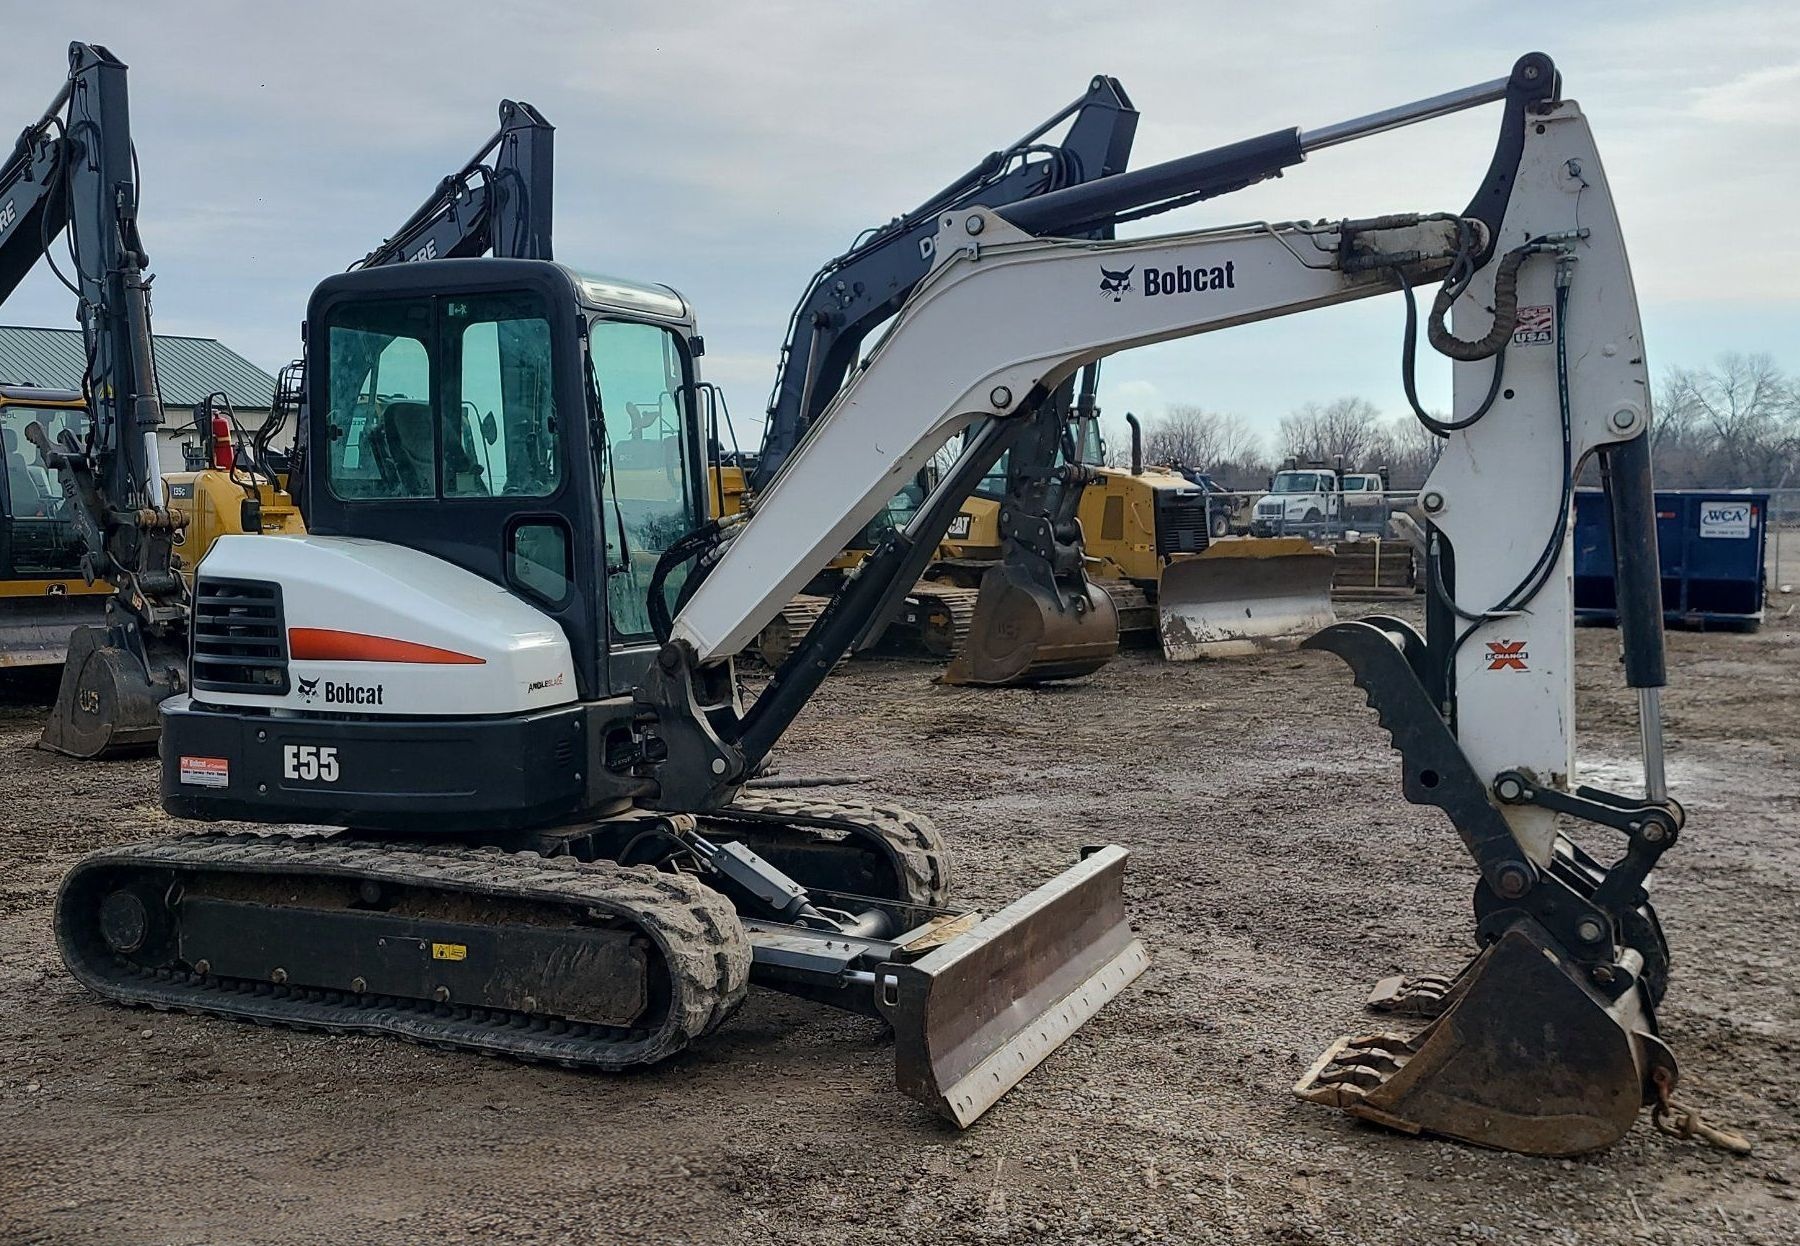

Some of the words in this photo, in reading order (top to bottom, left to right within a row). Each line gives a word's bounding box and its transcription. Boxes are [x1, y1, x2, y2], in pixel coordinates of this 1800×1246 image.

[1143, 260, 1235, 297] Bobcat
[1514, 332, 1550, 343] USA
[1708, 510, 1743, 521] WCA
[324, 681, 384, 705] Bobcat
[284, 744, 340, 782] E55
